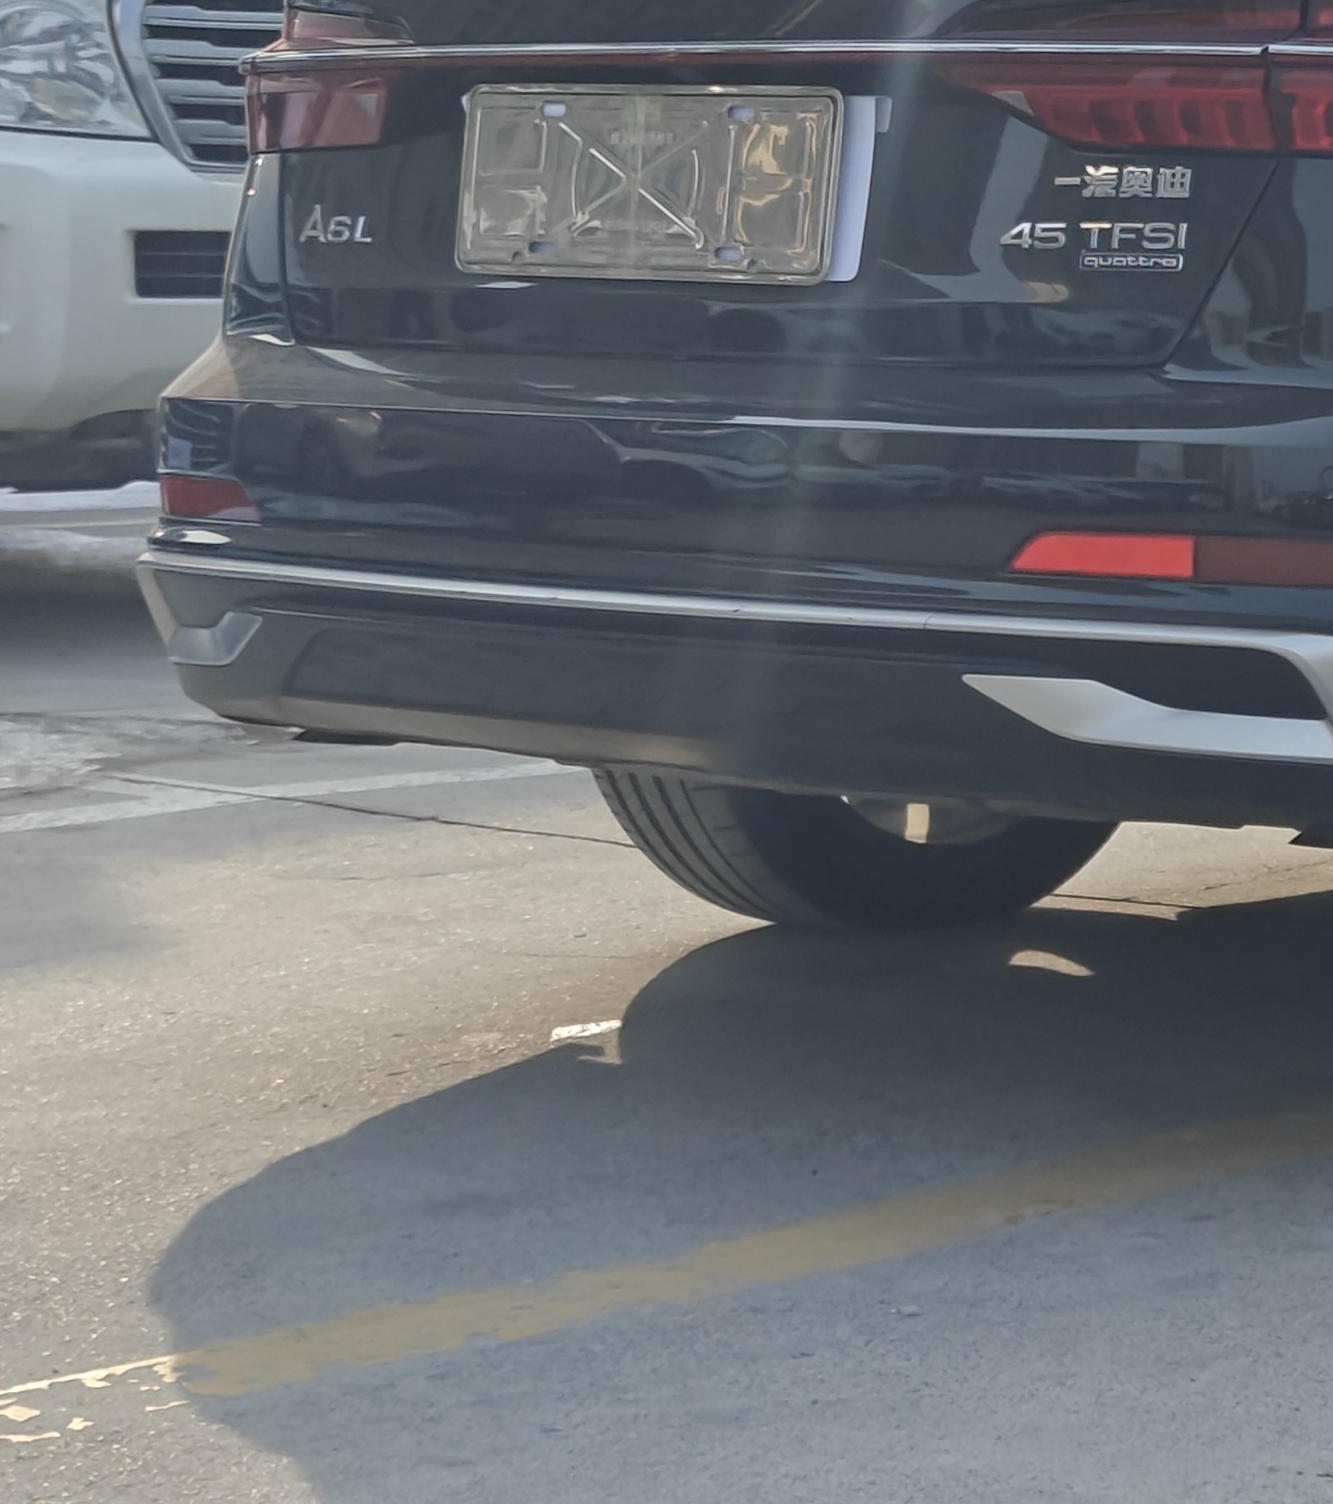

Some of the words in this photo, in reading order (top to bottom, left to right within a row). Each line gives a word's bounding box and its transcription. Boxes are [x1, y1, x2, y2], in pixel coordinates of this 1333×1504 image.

[1054, 165, 1192, 198] 一汽奥迪
[299, 204, 373, 244] A6L
[1000, 222, 1067, 249] 45
[1079, 222, 1188, 249] TFSI
[1082, 254, 1178, 268] quattro
